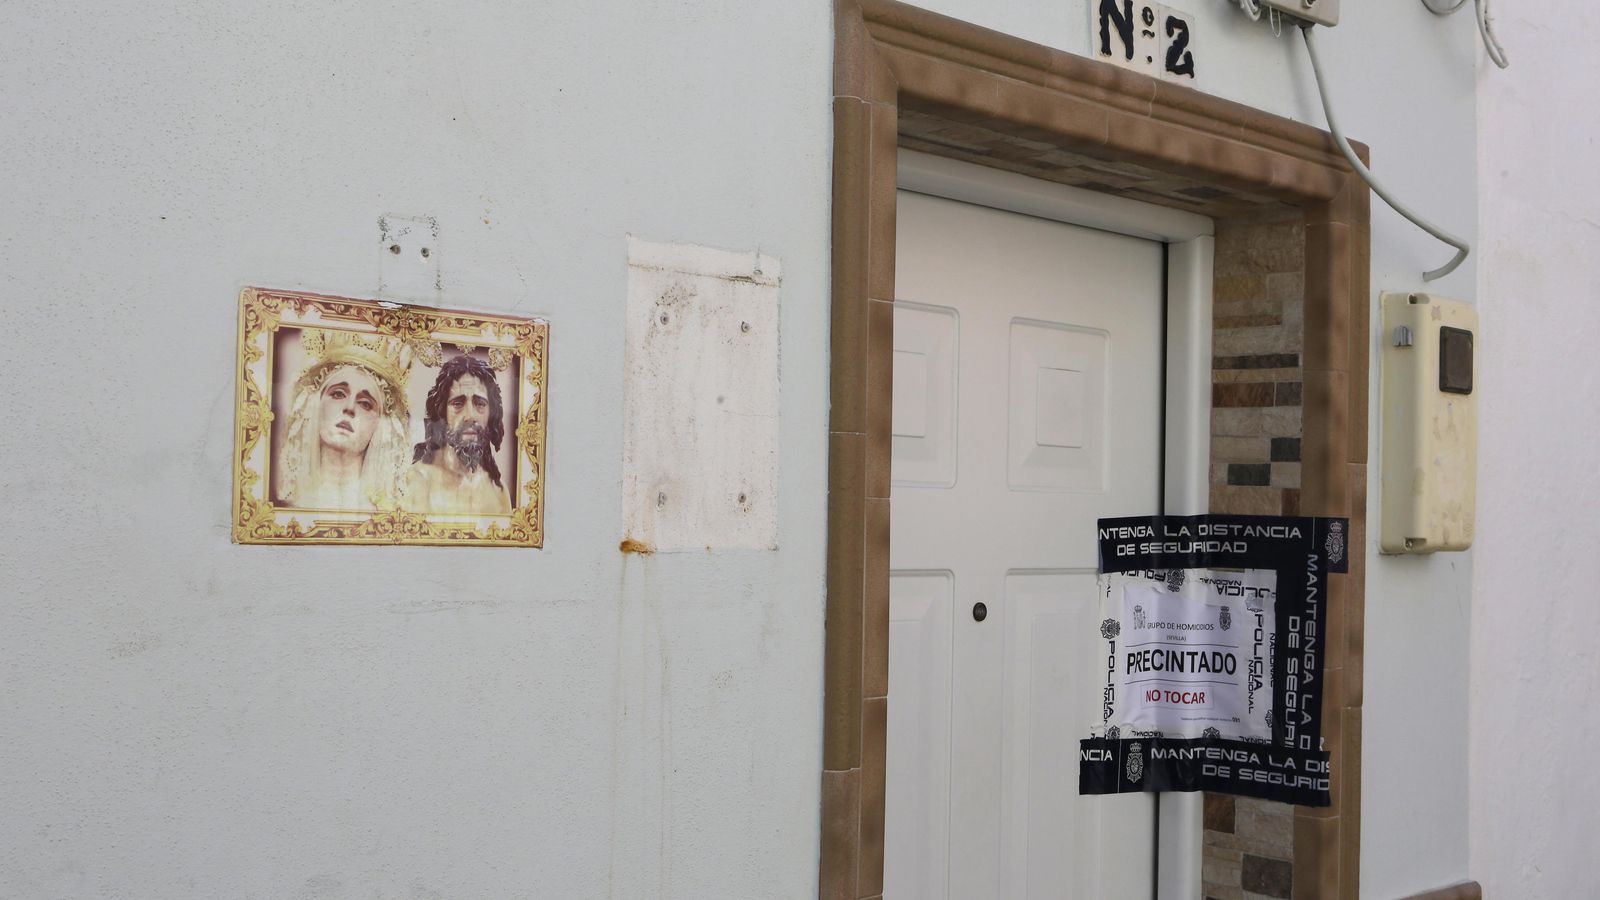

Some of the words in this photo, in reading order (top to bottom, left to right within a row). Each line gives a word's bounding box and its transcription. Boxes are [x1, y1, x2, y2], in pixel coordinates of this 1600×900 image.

[1166, 16, 1194, 78] 2
[1164, 525, 1190, 537] LA
[1198, 524, 1302, 539] DISTANCIA
[1117, 544, 1135, 556] DE
[1140, 541, 1247, 555] SEGURIDAD
[1216, 584, 1276, 598] OLICIA
[1167, 622, 1175, 630] DE
[1302, 554, 1319, 684] MANTENGA
[1288, 616, 1300, 648] DE
[1127, 649, 1237, 675] PRECINTADO
[1254, 614, 1263, 690] POLICIA
[1146, 690, 1161, 703] NO
[1164, 691, 1206, 704] TOCAR
[1285, 657, 1298, 748] SEGURI
[1300, 694, 1312, 725] LA
[1080, 749, 1113, 761] NCIA
[1151, 748, 1260, 765] MANTENGA
[1269, 756, 1297, 769] LA
[1202, 765, 1230, 778] DE
